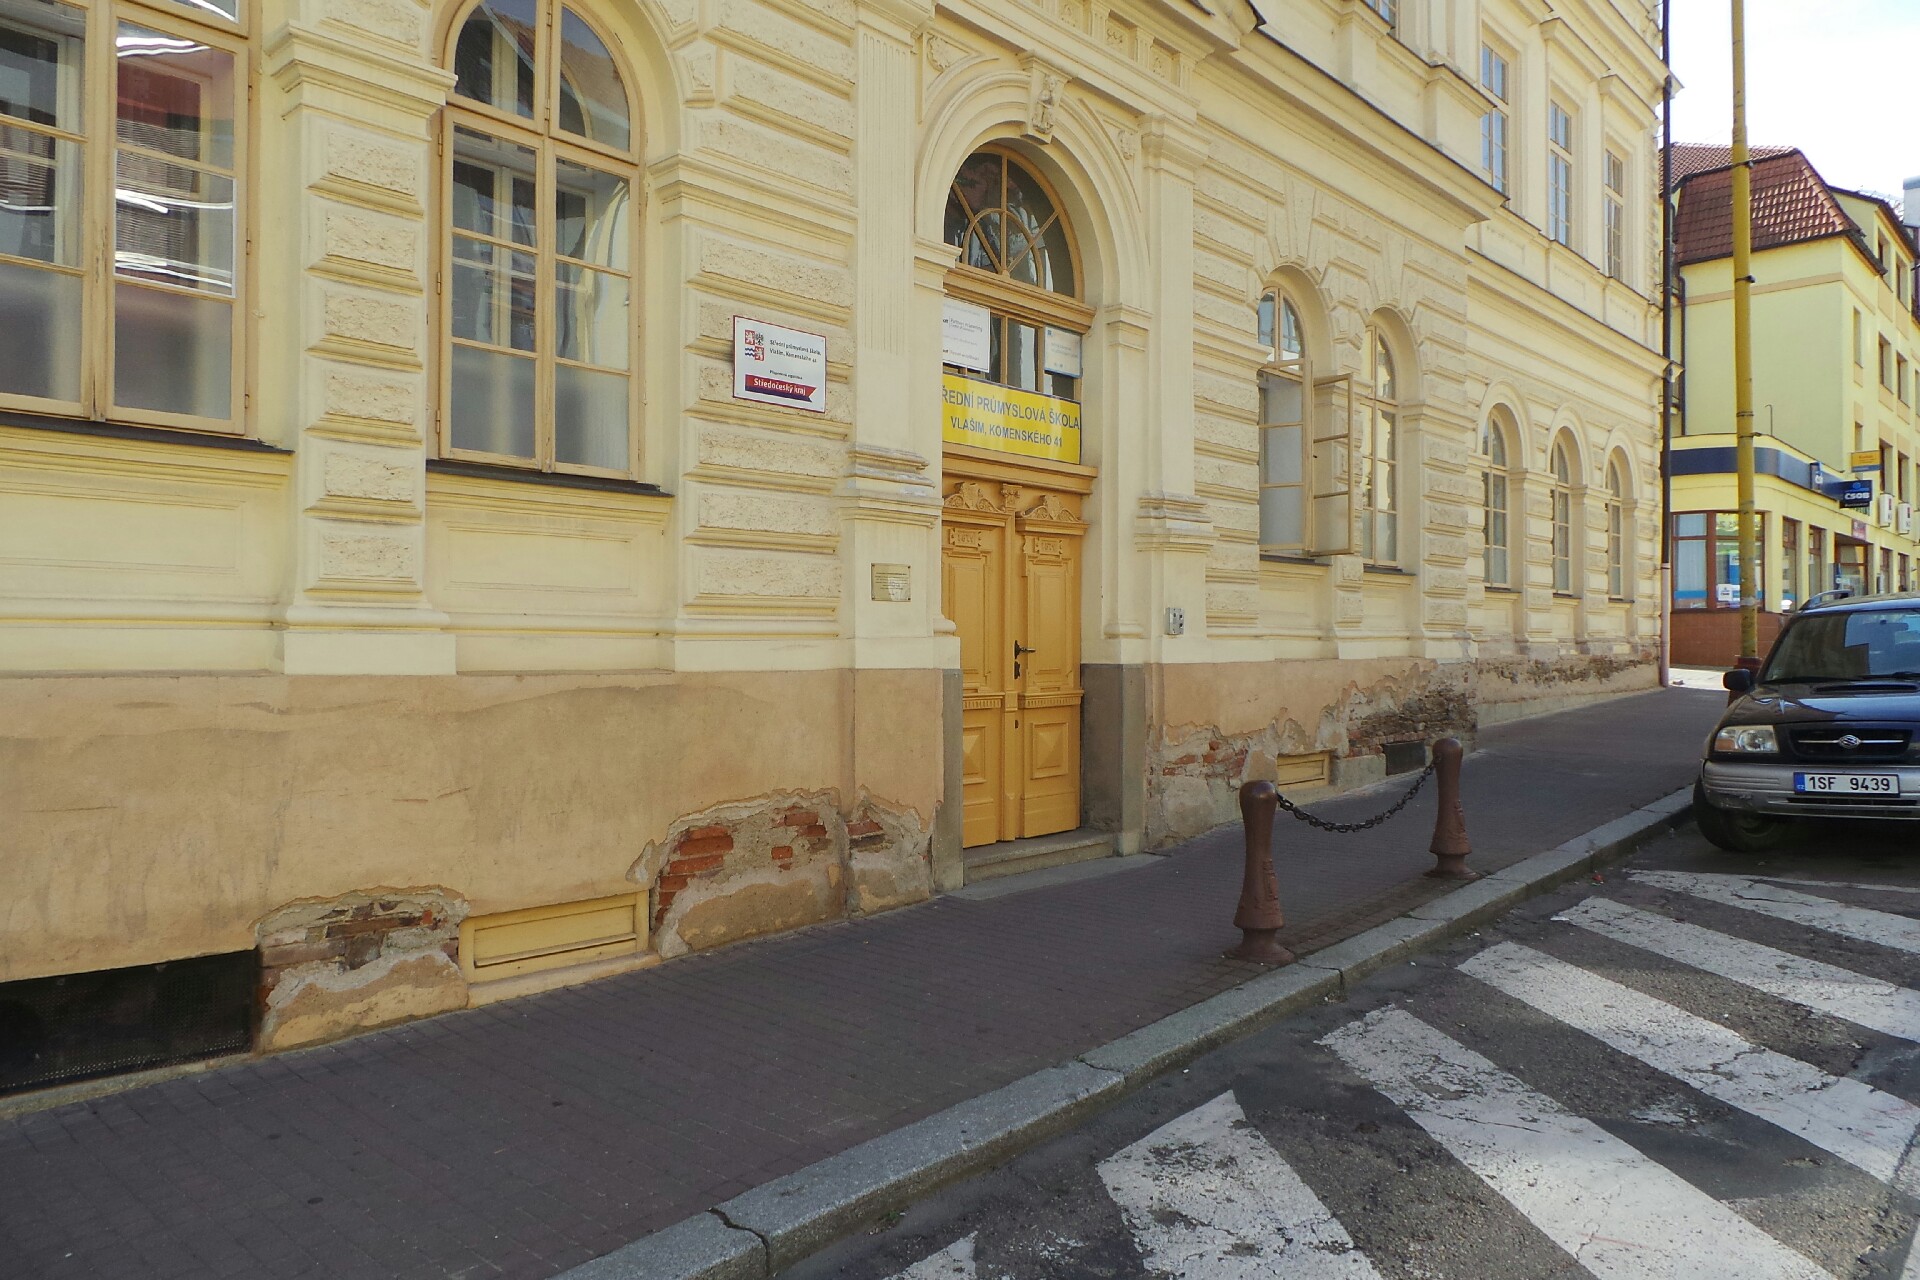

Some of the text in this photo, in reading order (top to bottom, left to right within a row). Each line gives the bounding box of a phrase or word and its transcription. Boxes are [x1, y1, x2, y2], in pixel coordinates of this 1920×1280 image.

[753, 378, 806, 395] Středočeský kraj
[942, 385, 973, 408] ŘEDNÍ
[1049, 408, 1079, 430] ŠKOLA
[950, 416, 1063, 448] VLAŠIM, KOMENSKÉHO 41
[1808, 776, 1890, 792] 1SF 9439
